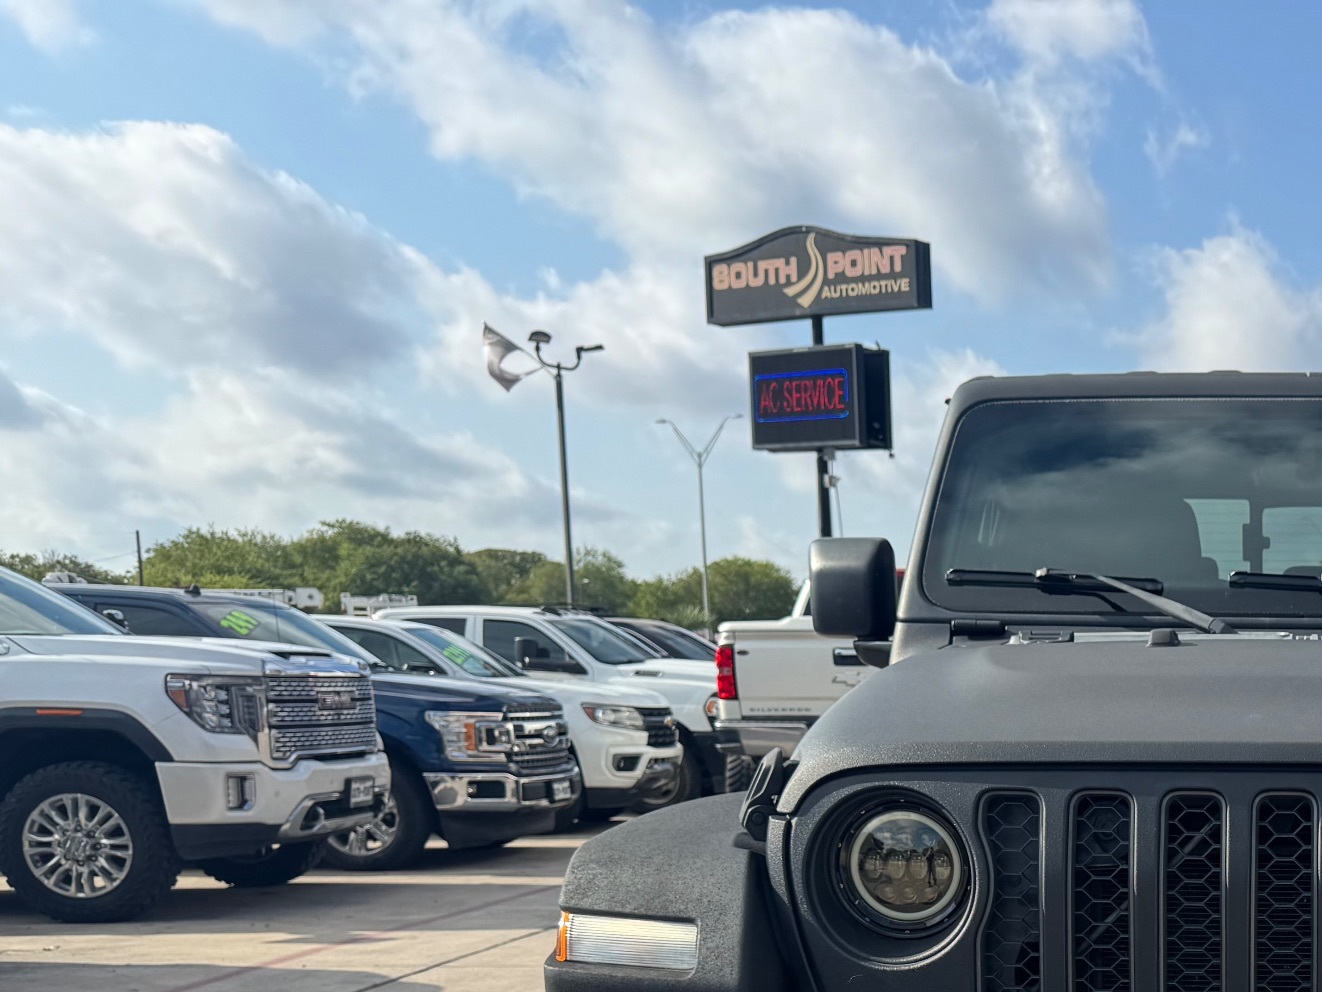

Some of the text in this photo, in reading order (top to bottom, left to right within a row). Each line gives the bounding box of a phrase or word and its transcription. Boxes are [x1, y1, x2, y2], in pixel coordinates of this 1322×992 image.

[712, 245, 907, 291] SOUTH POINT
[821, 278, 910, 300] AUTOMOTIVE
[760, 377, 845, 414] AC SERVICE
